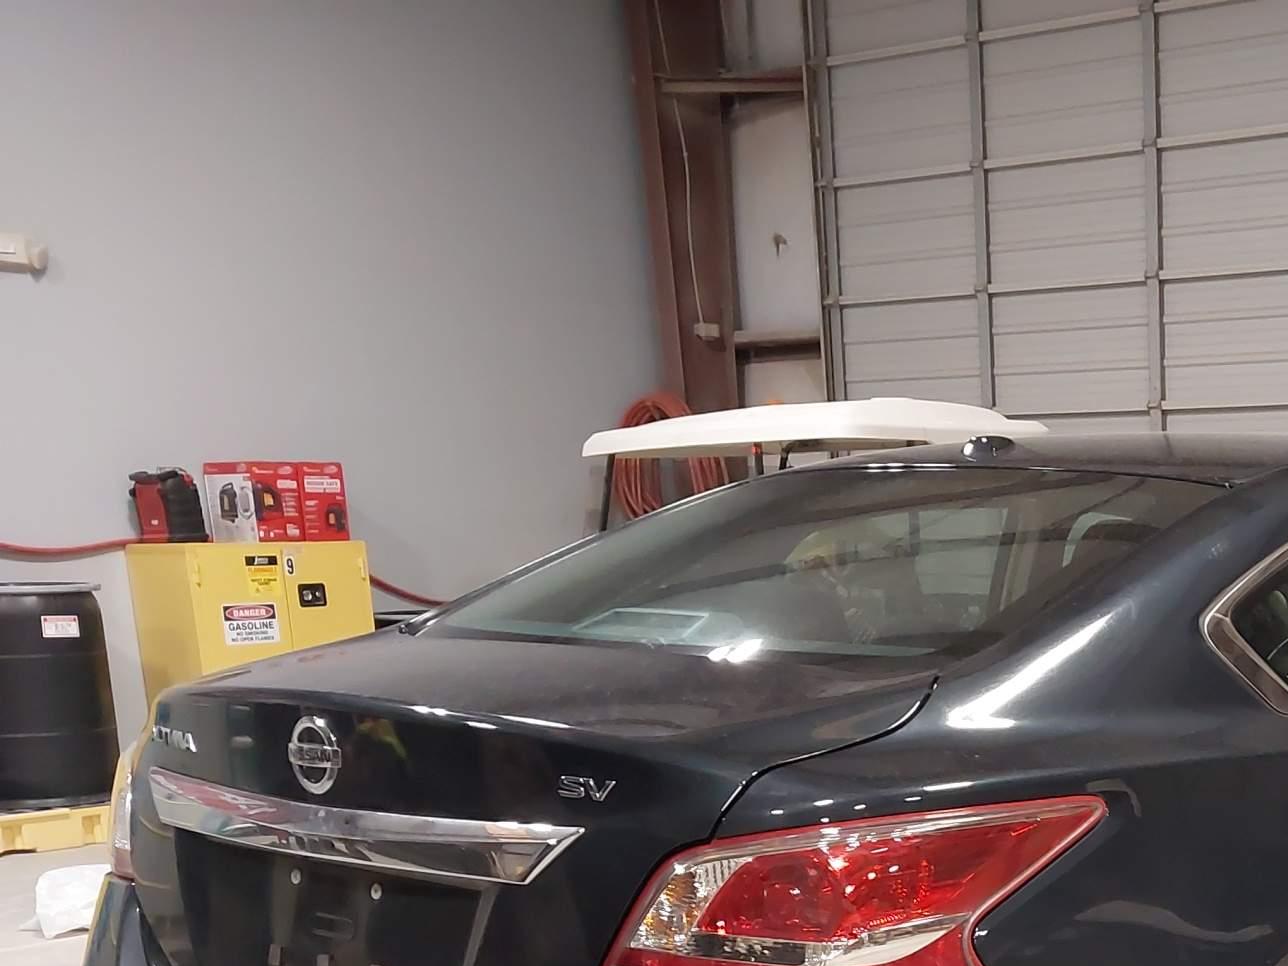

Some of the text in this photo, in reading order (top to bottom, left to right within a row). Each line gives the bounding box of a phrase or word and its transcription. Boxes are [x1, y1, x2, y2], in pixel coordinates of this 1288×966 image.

[287, 558, 294, 575] 9
[232, 608, 266, 617] DANGER
[228, 620, 275, 631] GASOLINE
[557, 775, 617, 802] SV
